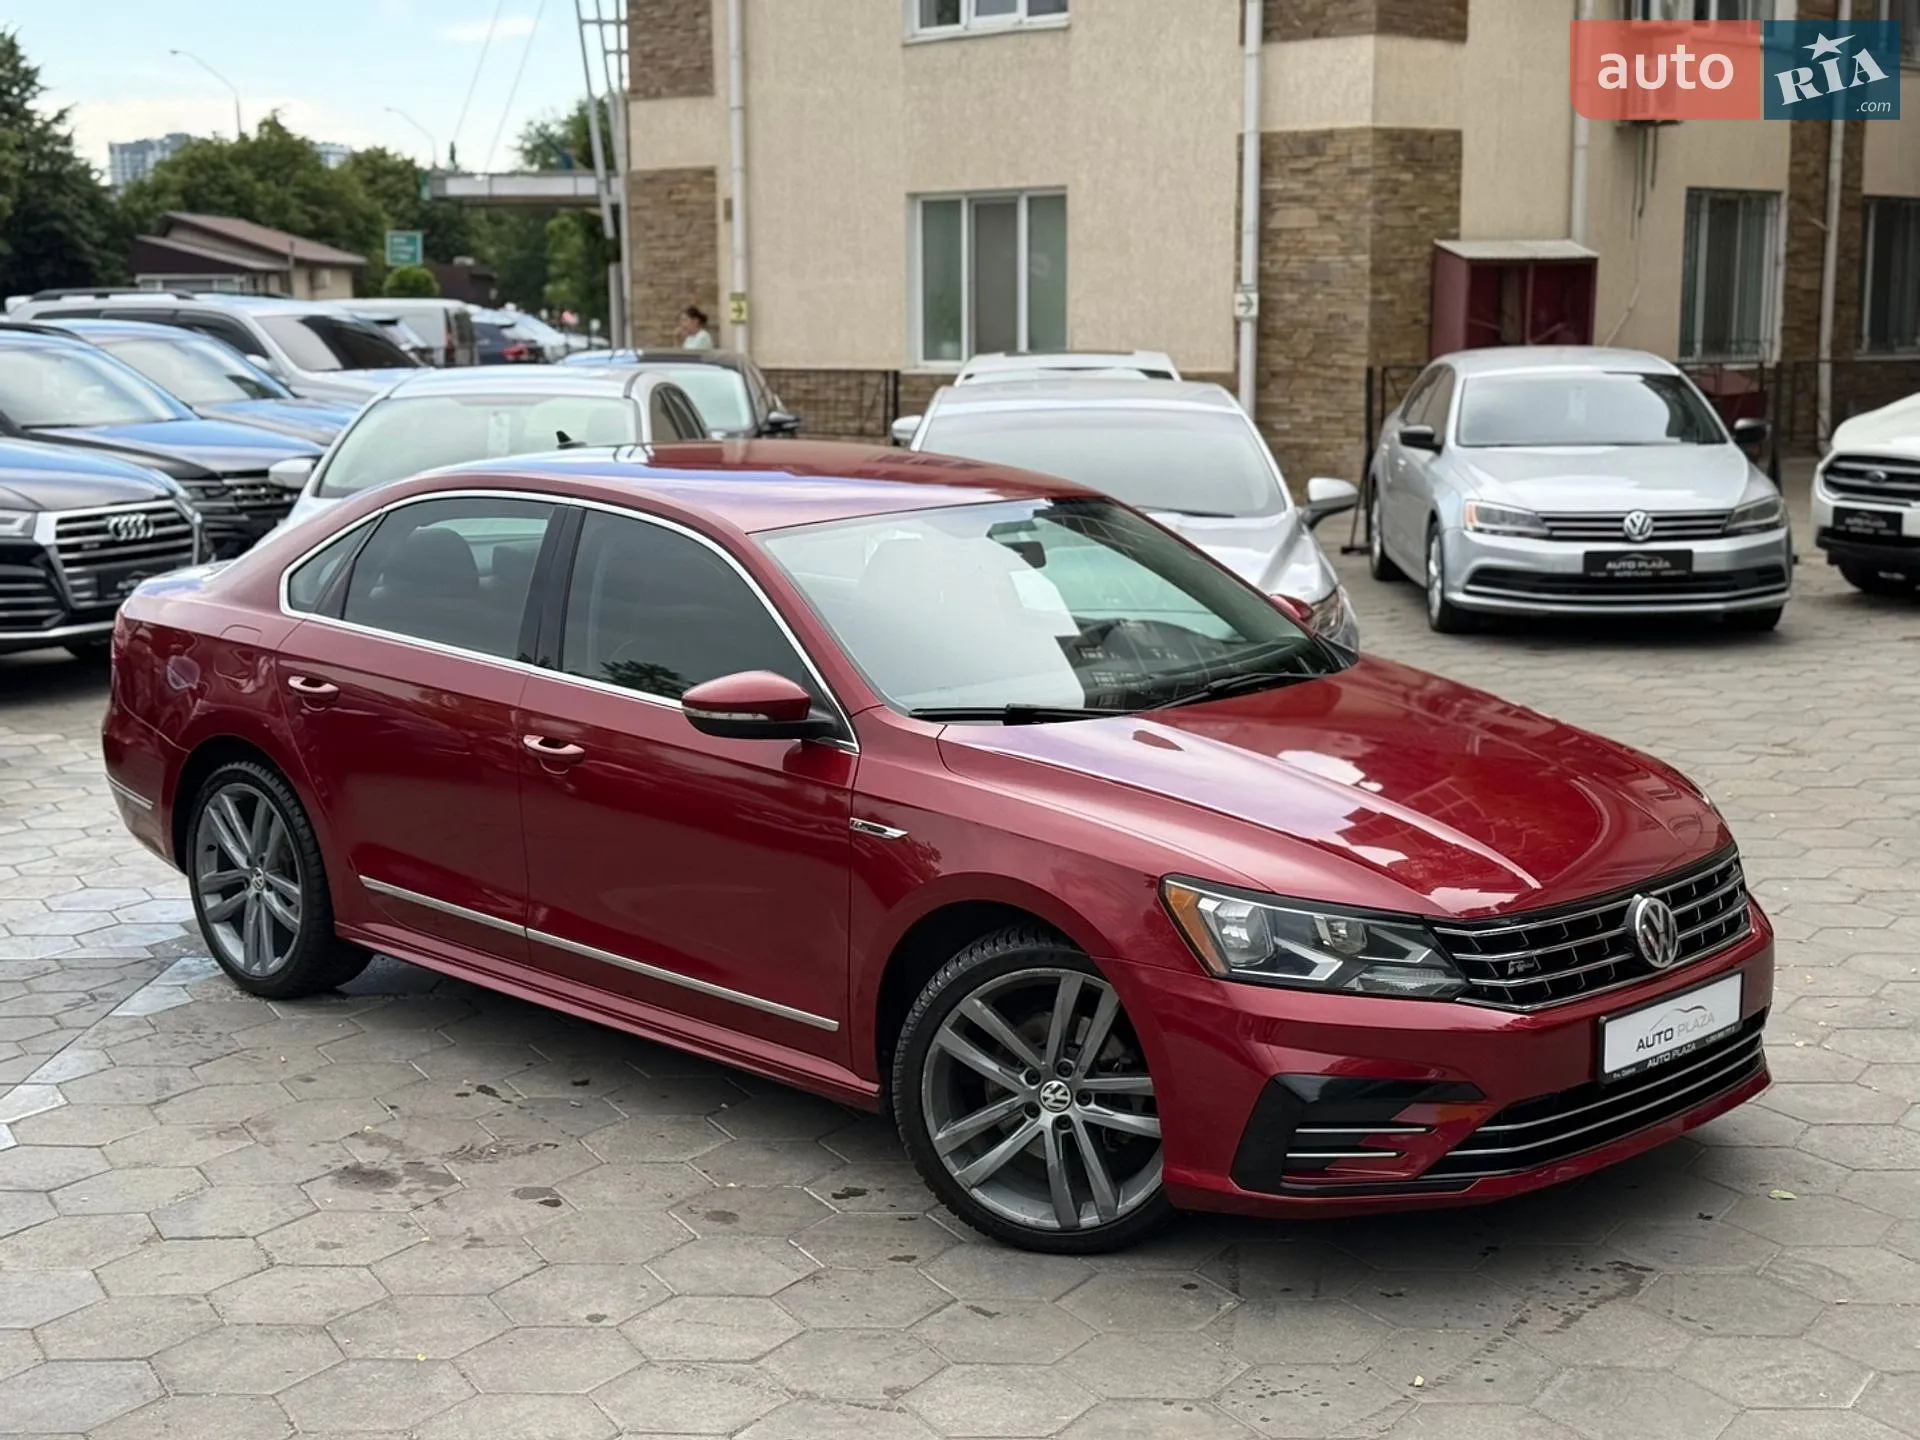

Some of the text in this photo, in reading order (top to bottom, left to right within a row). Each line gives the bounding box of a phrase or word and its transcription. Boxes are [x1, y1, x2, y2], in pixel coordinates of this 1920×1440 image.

[1635, 1027, 1675, 1053] AUTO
[1676, 1012, 1716, 1038] PLAZA
[1646, 1043, 1697, 1069] AUTO PLAZA
